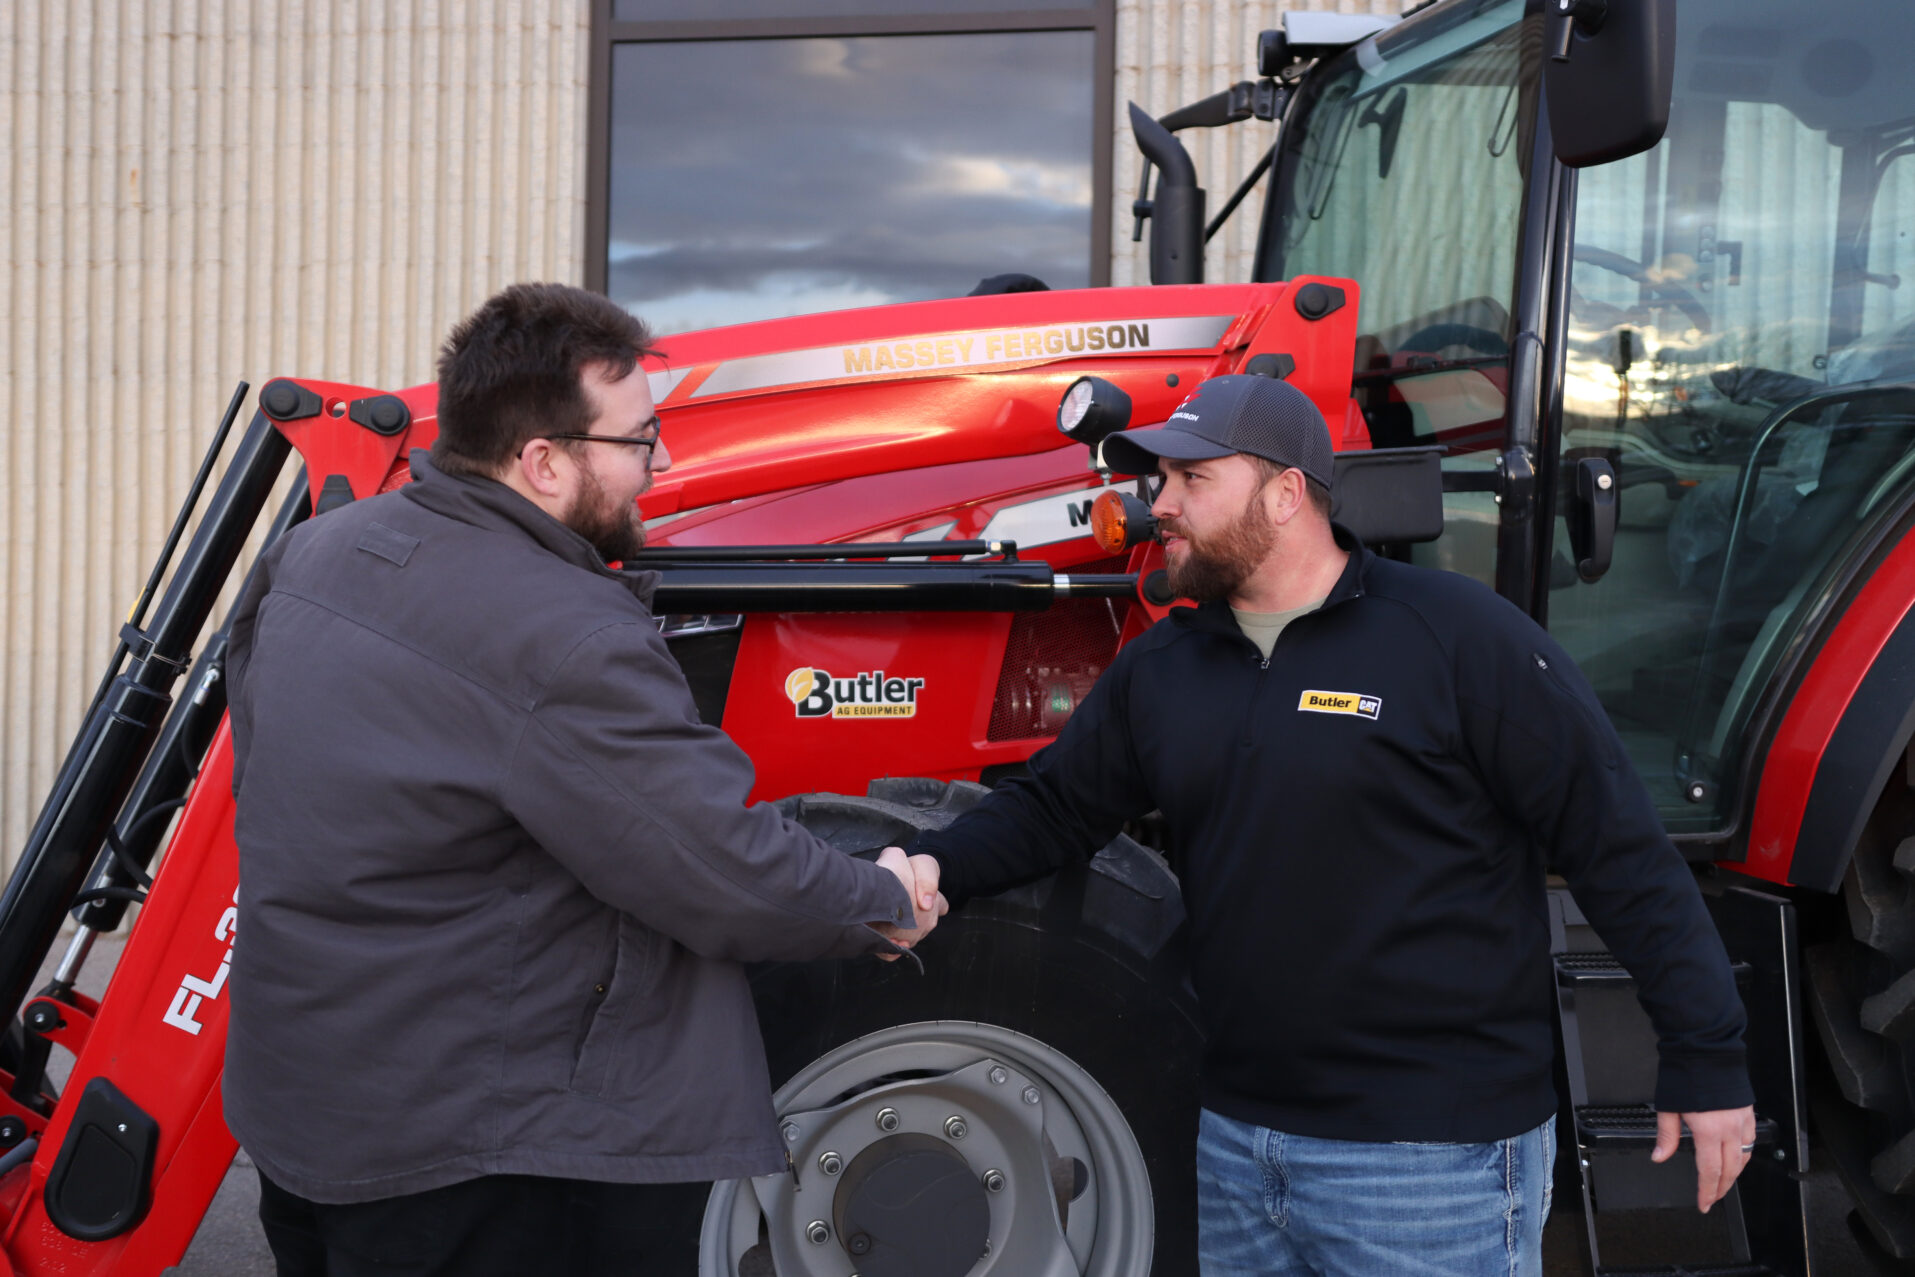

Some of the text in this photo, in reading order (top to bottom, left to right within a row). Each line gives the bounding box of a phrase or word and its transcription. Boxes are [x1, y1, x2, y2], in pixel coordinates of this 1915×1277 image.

[843, 323, 1149, 373] MASSEY FERGUSON
[797, 671, 923, 716] Butler
[1309, 695, 1377, 713] Butler CAT
[836, 706, 912, 715] AG EQUIPMENT
